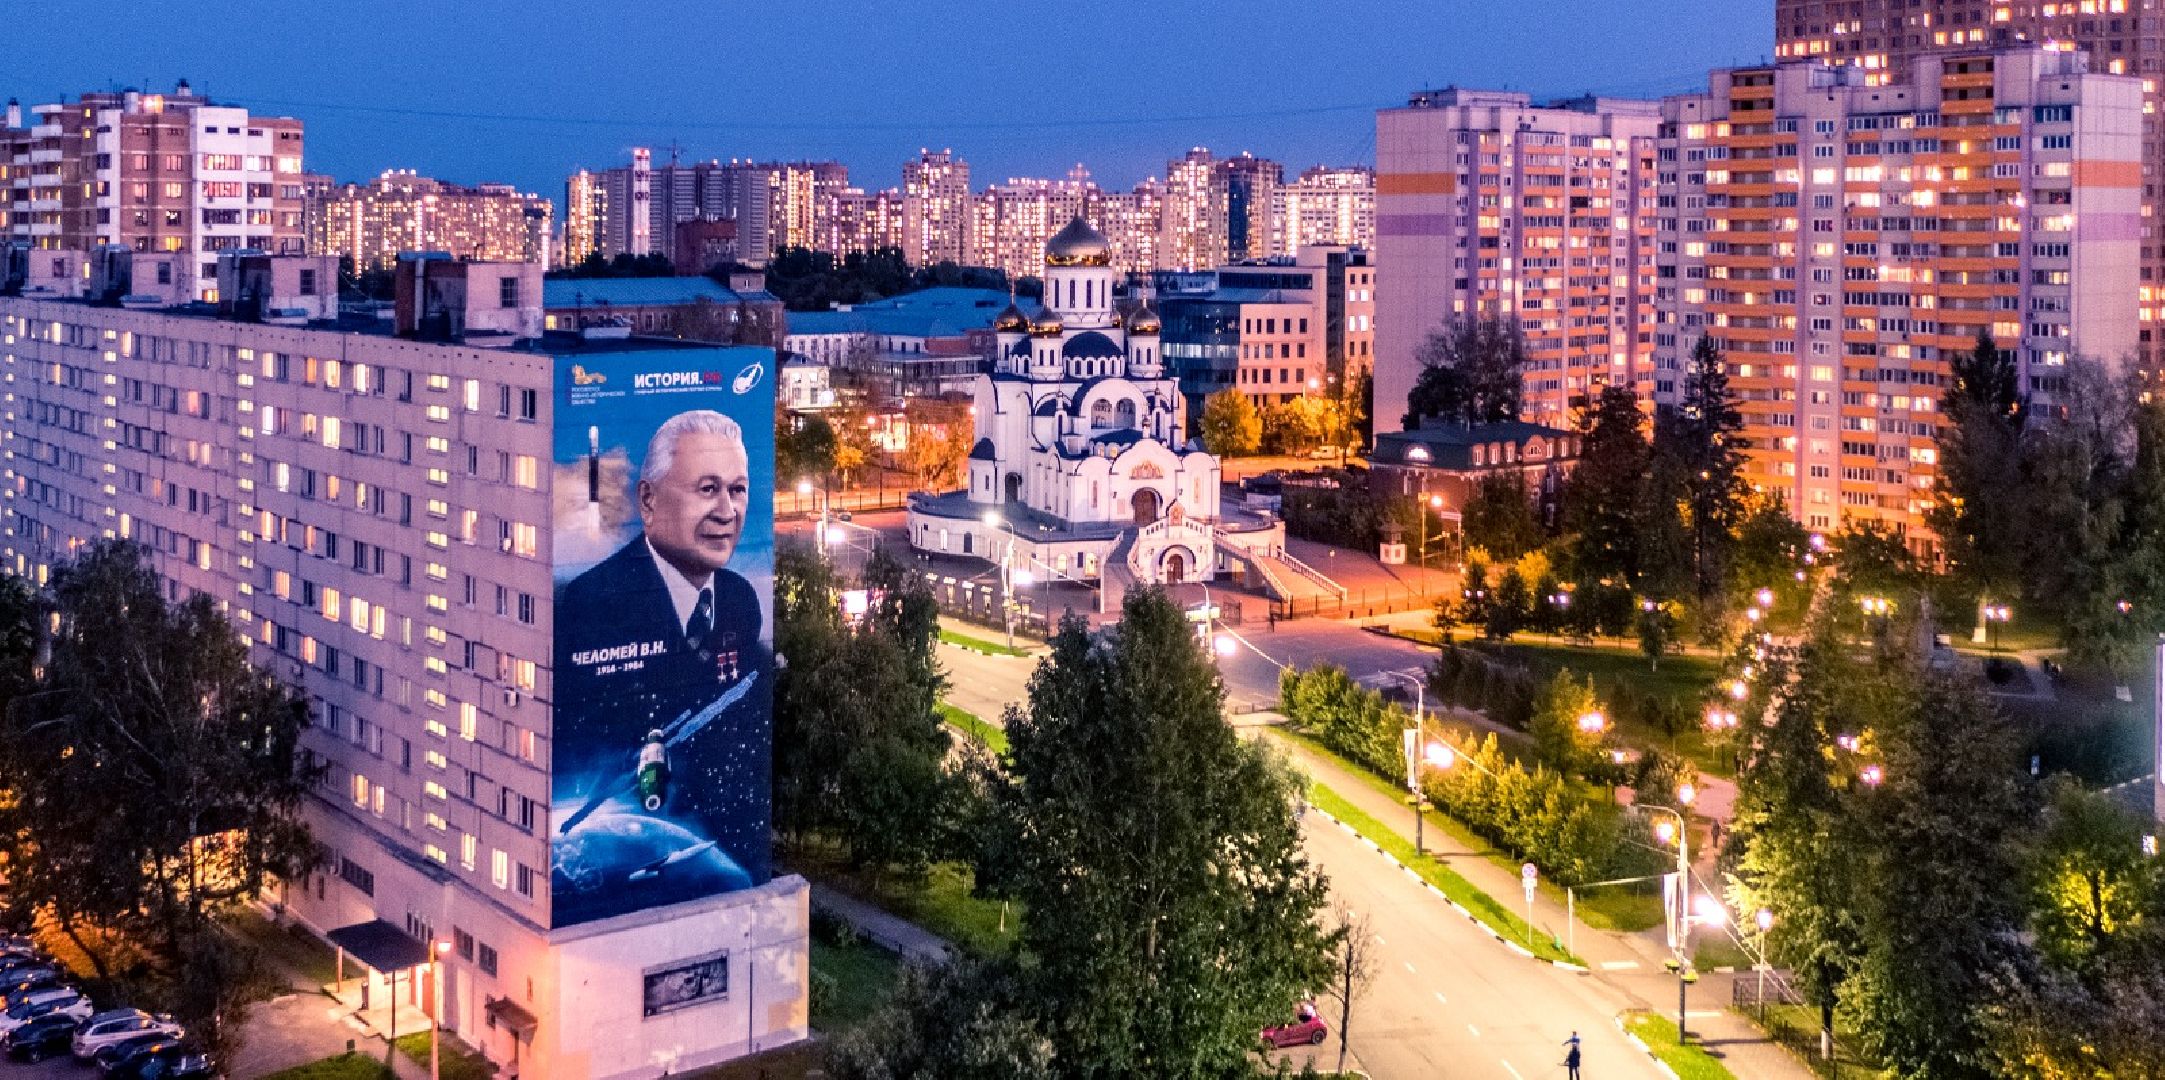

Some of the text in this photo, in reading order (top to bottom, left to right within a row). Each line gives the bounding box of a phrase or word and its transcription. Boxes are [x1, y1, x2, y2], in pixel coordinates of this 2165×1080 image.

[634, 371, 722, 389] ИСТОРИЯ.РФ
[572, 640, 668, 665] ЧЕЛОМЕЙ В.Н.
